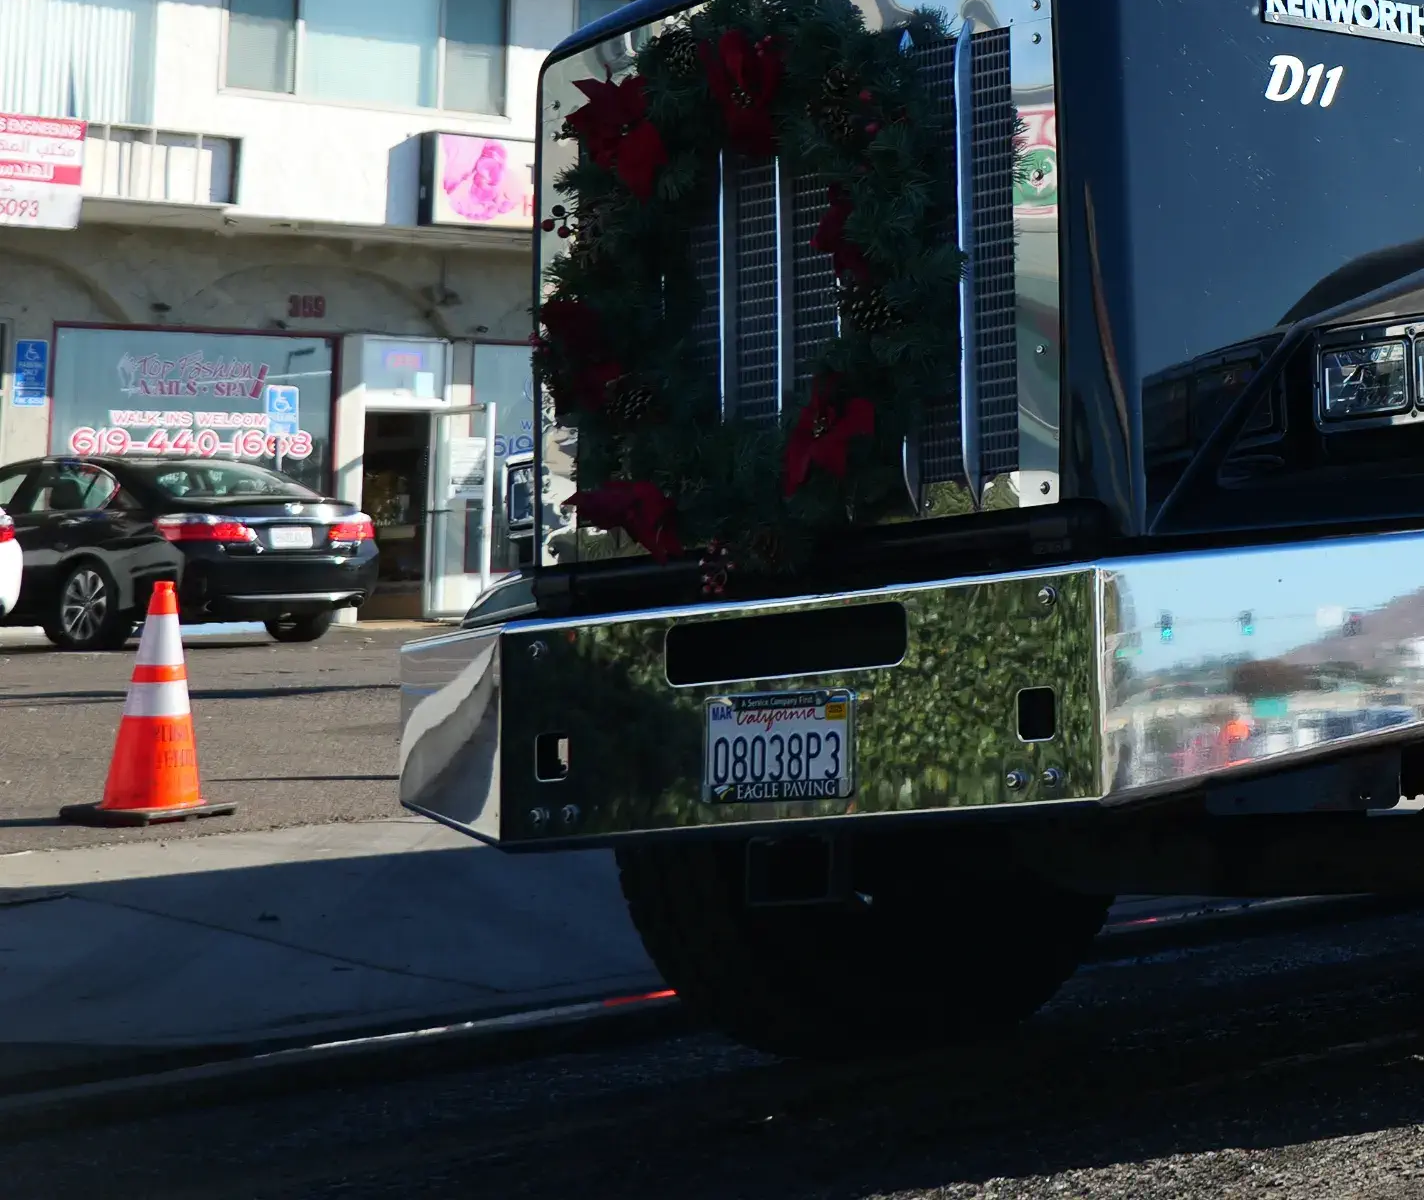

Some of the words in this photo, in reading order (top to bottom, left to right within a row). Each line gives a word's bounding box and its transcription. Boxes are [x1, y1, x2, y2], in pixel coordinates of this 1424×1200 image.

[1264, 54, 1344, 108] D11
[7, 118, 82, 140] ENGINEERING
[178, 349, 253, 379] Fashion
[140, 379, 198, 398] NAILS
[213, 380, 252, 399] SPA
[110, 410, 193, 428] WALK-INS
[196, 412, 268, 429] WELCOM
[711, 705, 732, 721] MAR
[736, 706, 824, 732] California
[713, 730, 841, 784] 08038P3
[736, 783, 782, 800] EAGLE
[783, 779, 836, 799] PAVING
